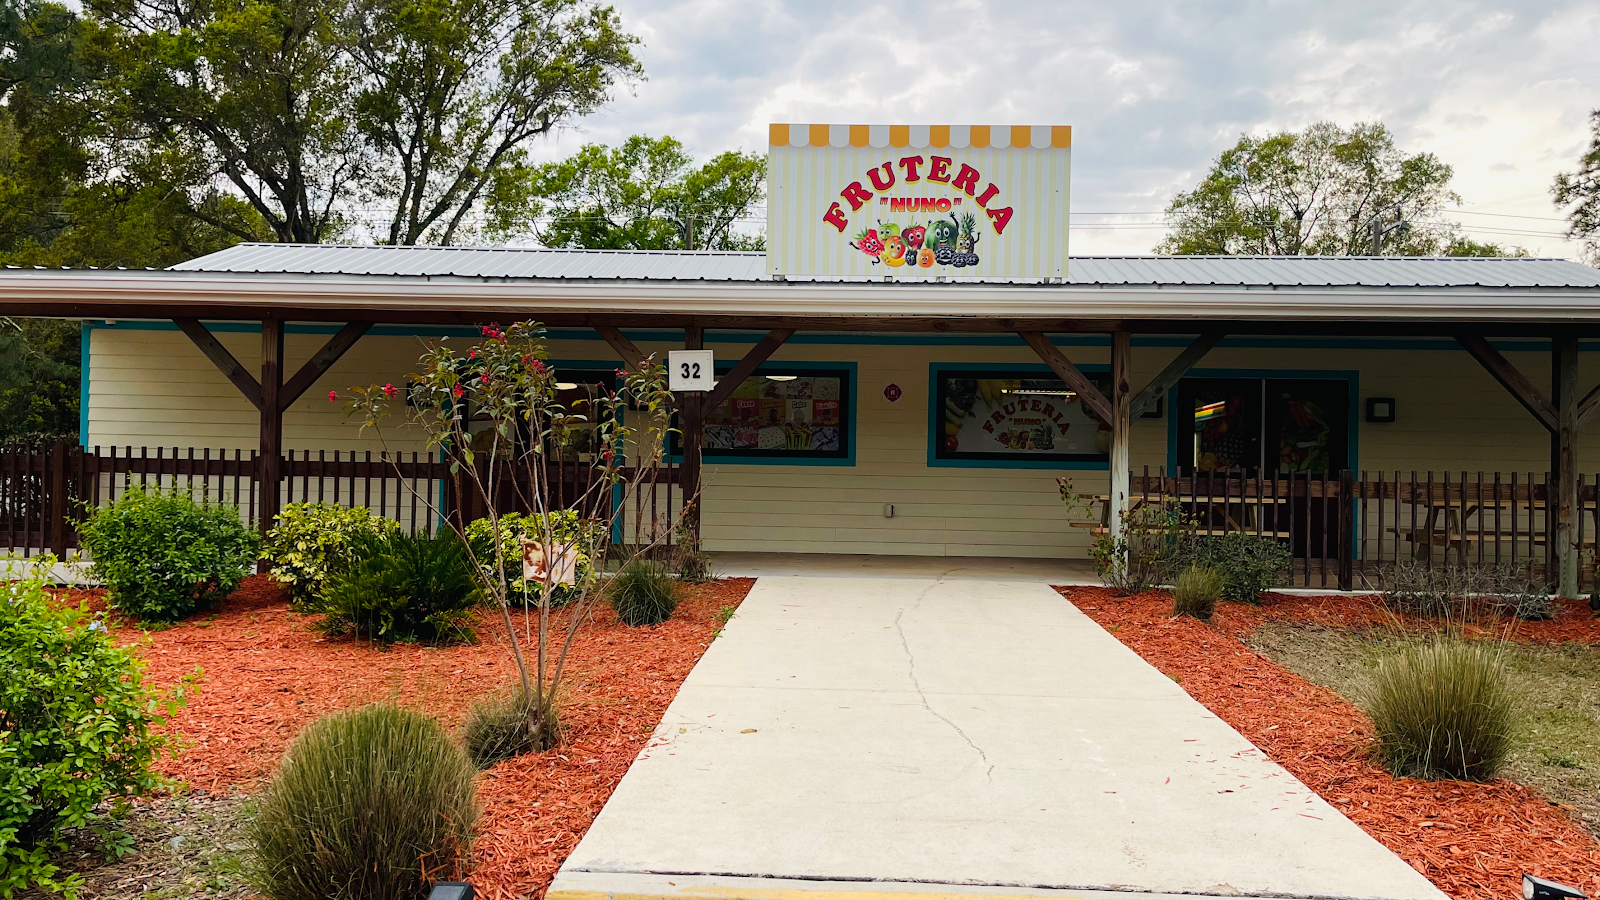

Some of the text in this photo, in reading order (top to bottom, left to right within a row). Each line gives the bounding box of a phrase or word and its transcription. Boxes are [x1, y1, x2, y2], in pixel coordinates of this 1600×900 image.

[822, 155, 1014, 236] FRUTERIA
[880, 197, 962, 213] "NUNO"
[681, 362, 701, 379] 32
[982, 399, 1071, 436] FRUTERIA
